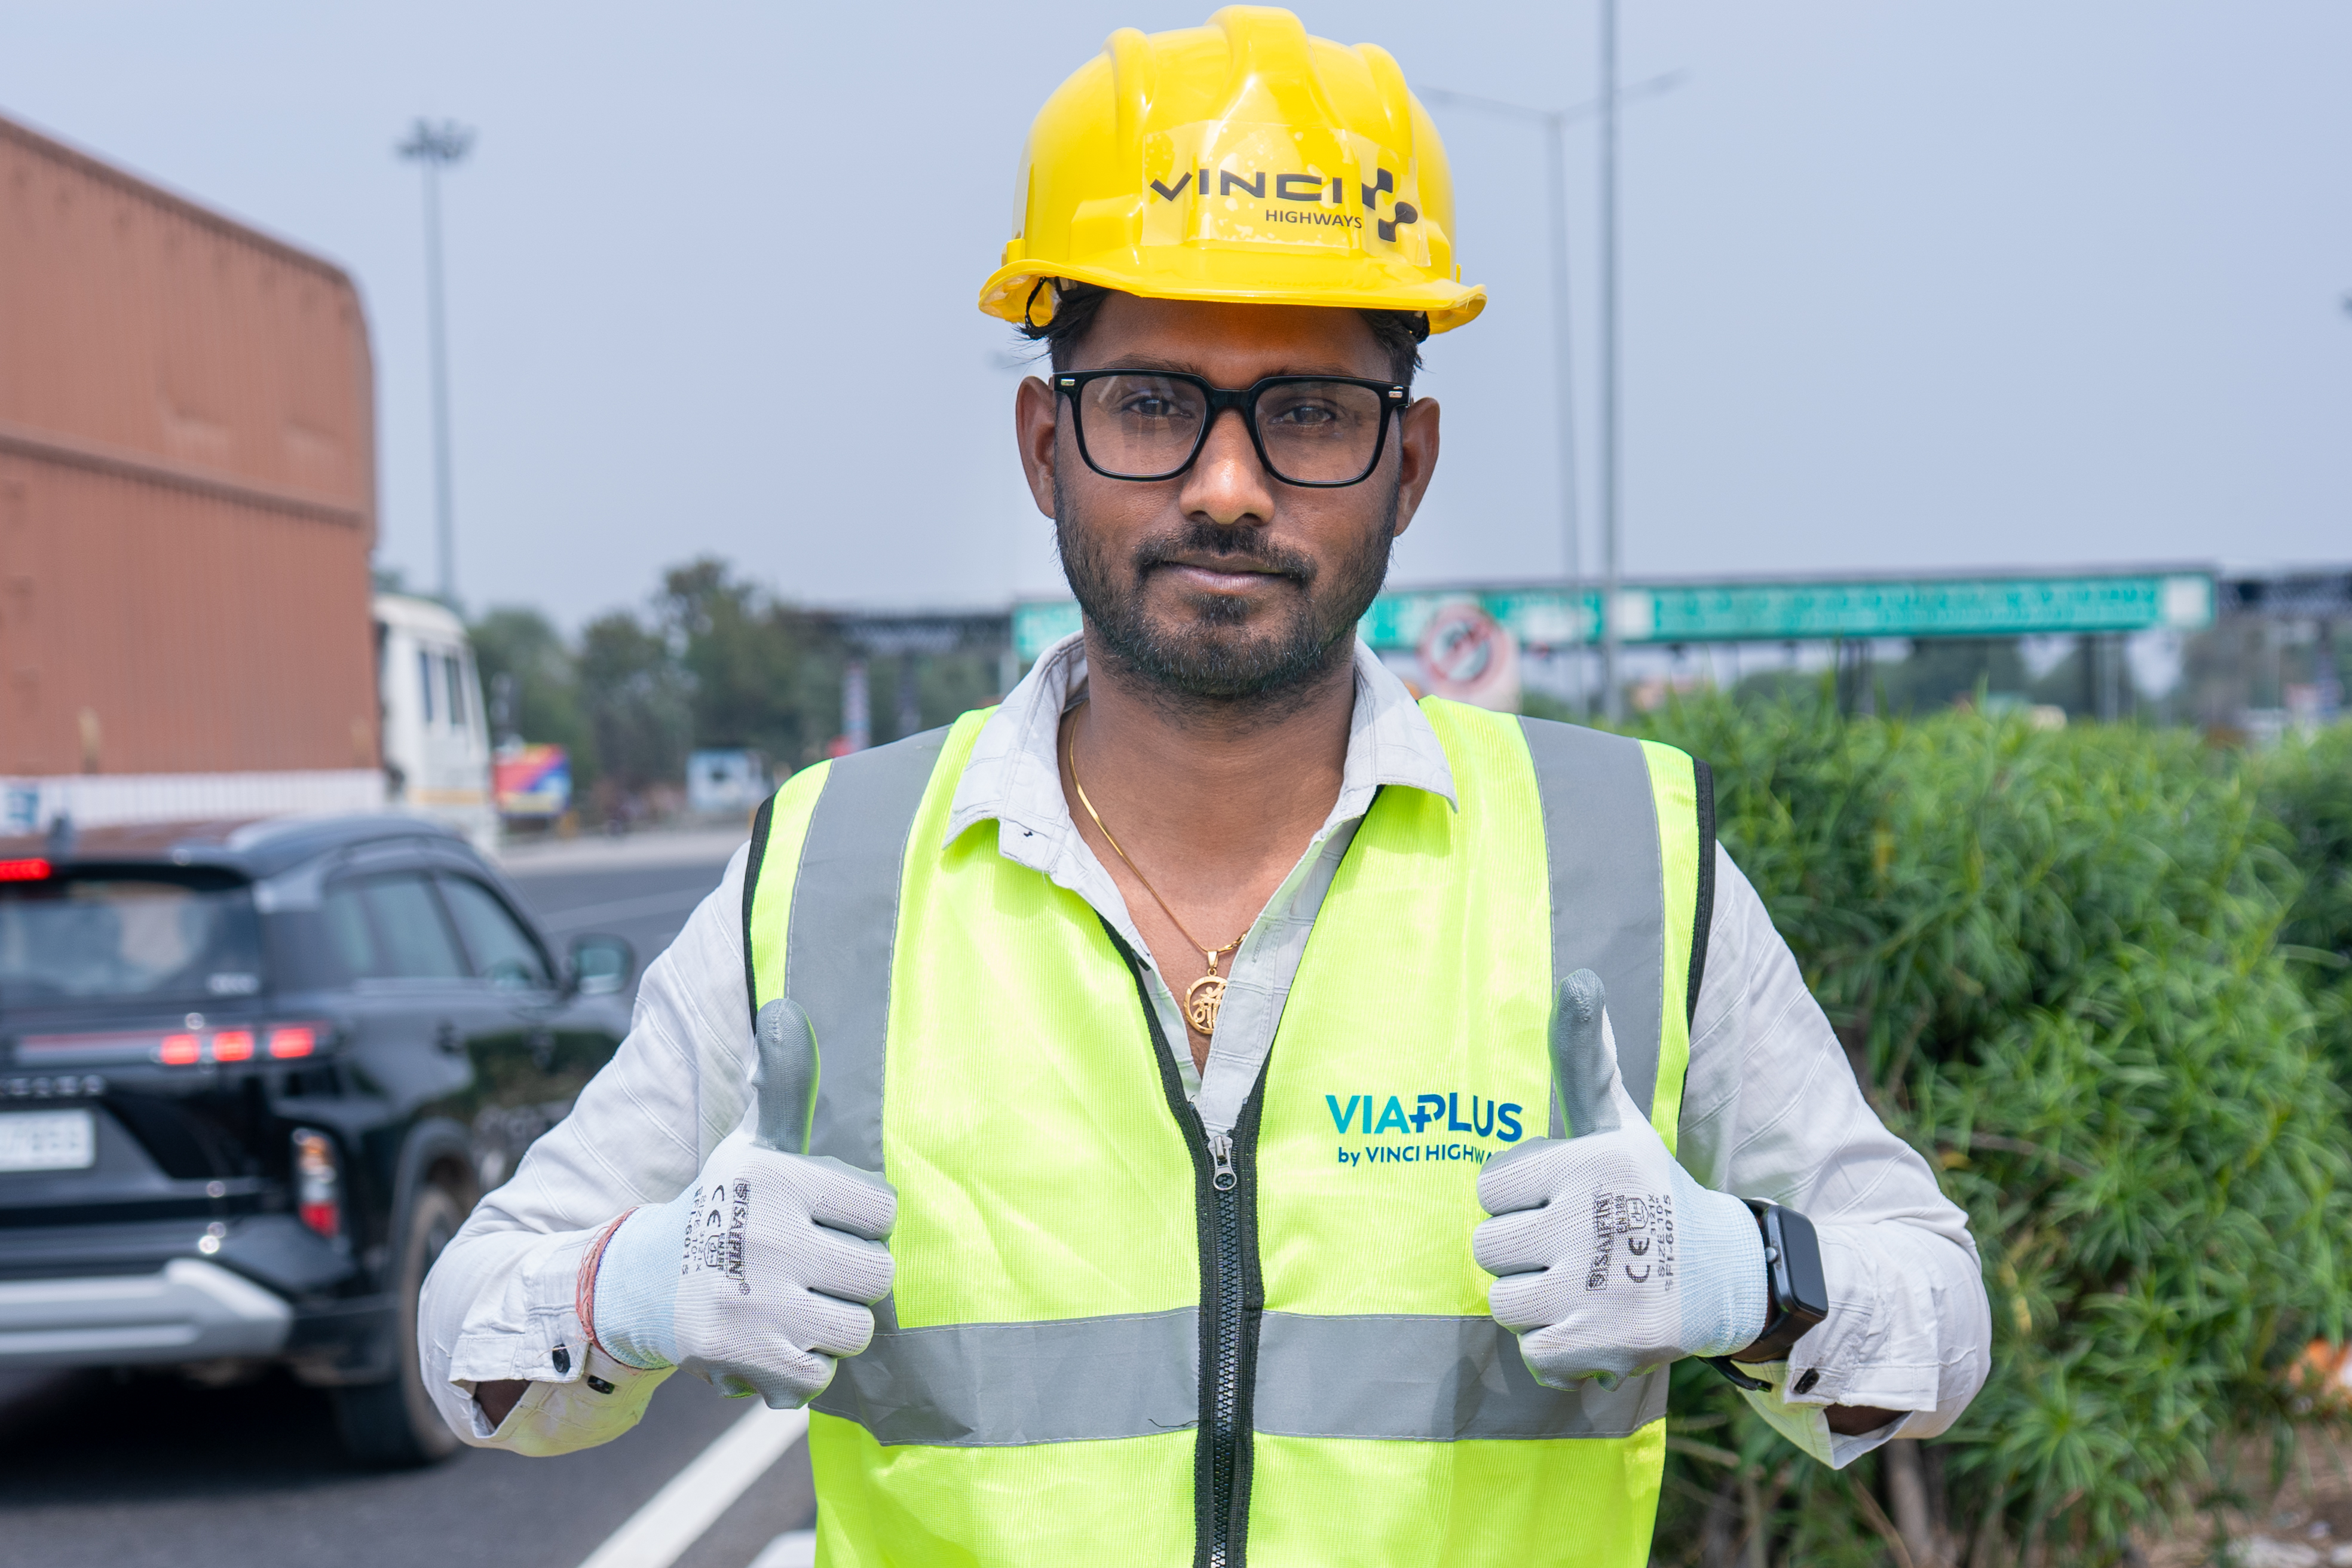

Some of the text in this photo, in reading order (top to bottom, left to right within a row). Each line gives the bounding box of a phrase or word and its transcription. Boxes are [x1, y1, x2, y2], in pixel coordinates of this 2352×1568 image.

[1150, 168, 1343, 204] VINCI
[1265, 209, 1363, 229] HIGHWAYS
[1325, 1092, 1523, 1143] VIAPLUS
[1338, 1147, 1361, 1167] by
[1365, 1146, 1420, 1163] VINCI
